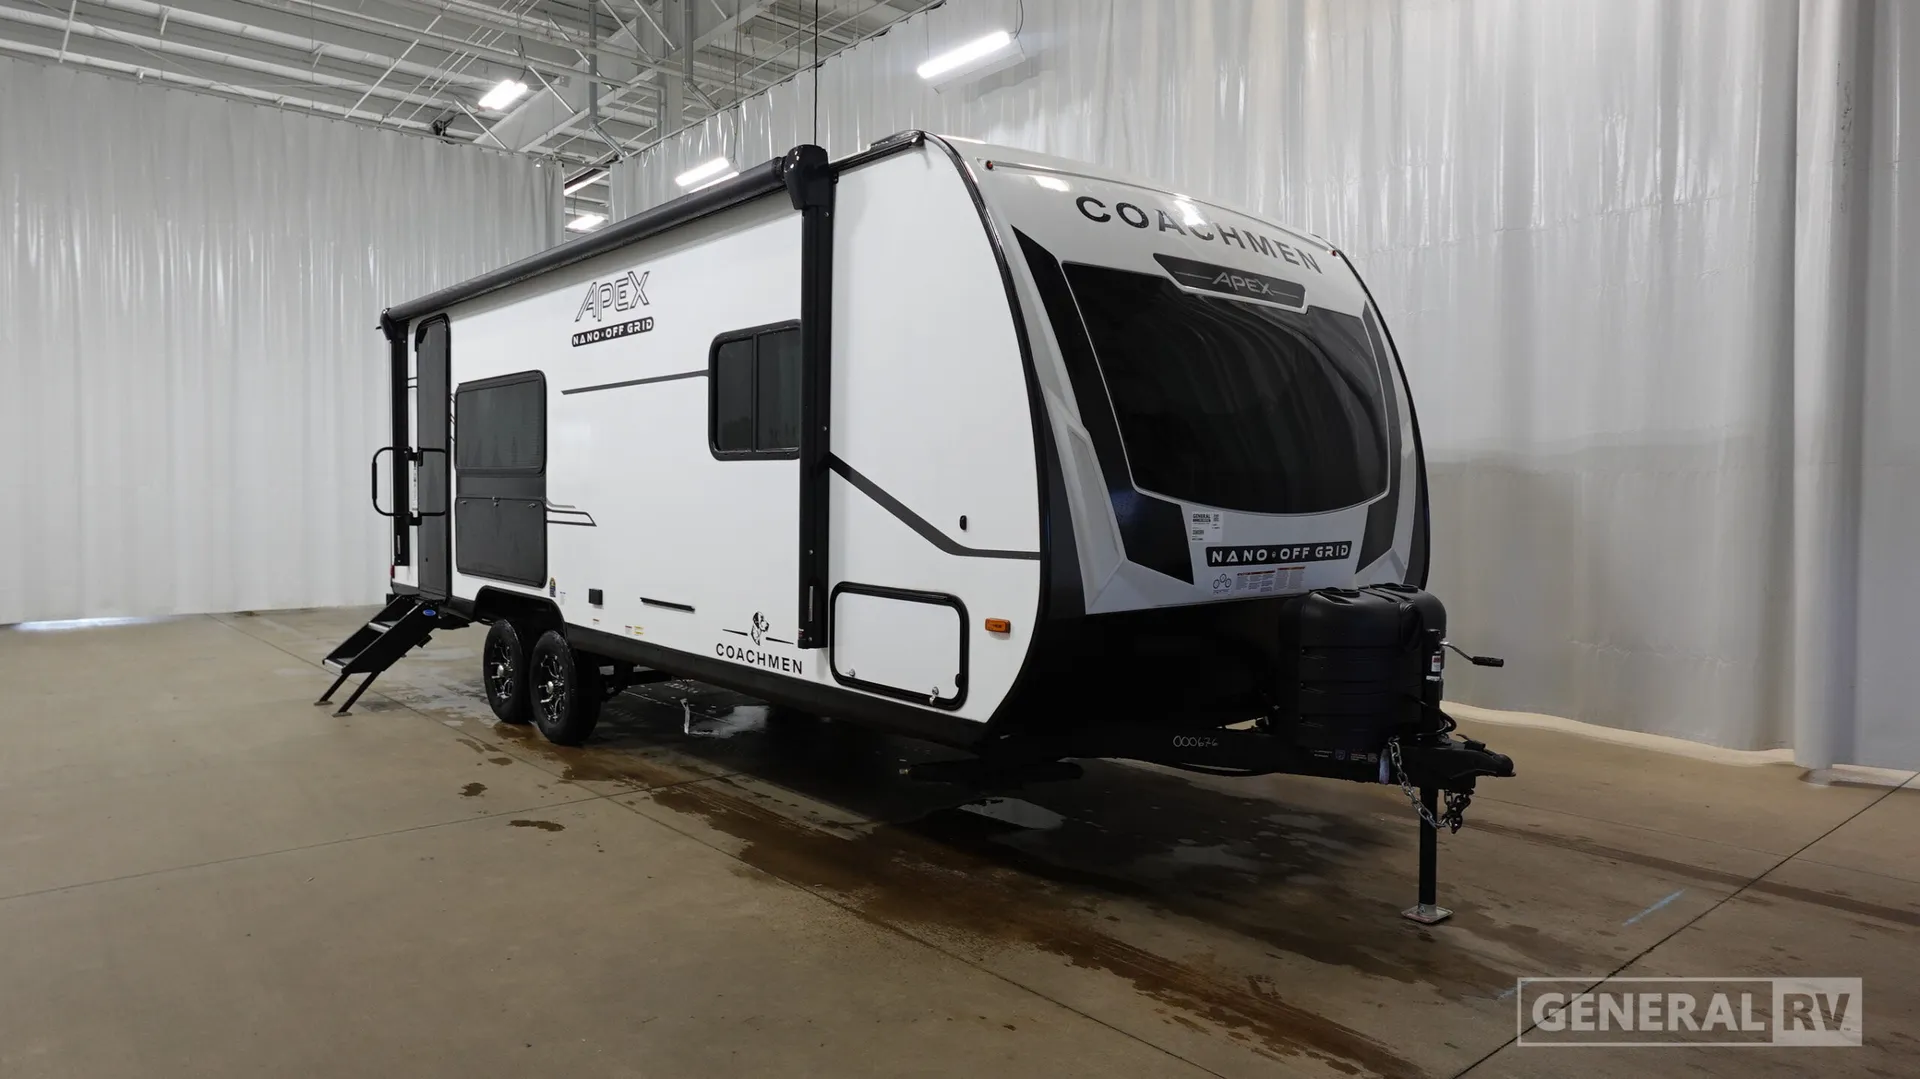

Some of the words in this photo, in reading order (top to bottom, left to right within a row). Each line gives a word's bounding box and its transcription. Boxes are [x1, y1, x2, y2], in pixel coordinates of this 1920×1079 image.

[1076, 196, 1322, 274] COACHMEN
[575, 271, 650, 322] APEX
[1212, 271, 1274, 295] APEX
[573, 331, 600, 346] NANO
[605, 325, 625, 338] OFF
[627, 318, 653, 333] GRID
[1211, 548, 1267, 563] NANO
[1280, 546, 1310, 560] OFF
[1315, 544, 1349, 558] GRID
[715, 643, 802, 675] COACHMEN
